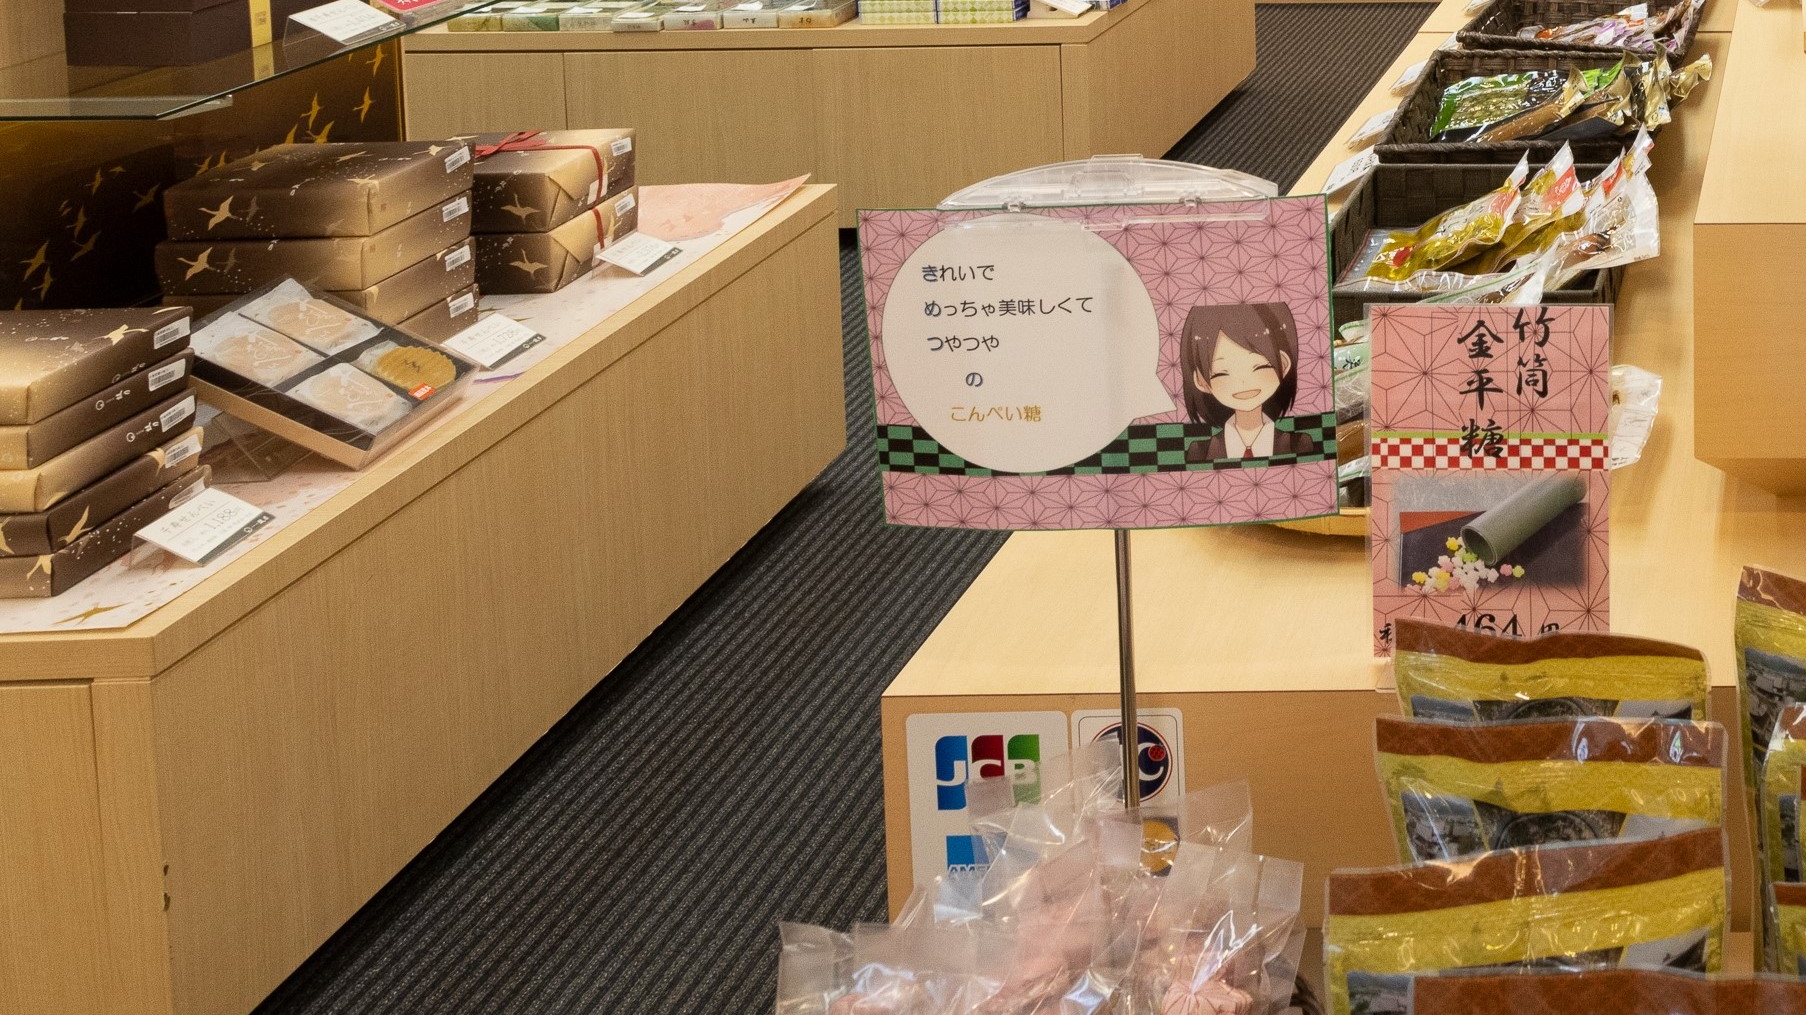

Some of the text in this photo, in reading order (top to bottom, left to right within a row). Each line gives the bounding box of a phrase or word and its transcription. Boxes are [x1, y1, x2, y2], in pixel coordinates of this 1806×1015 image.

[921, 262, 995, 283] きれいで
[924, 294, 1095, 317] めっちゃ美味しくて
[926, 333, 1000, 352] つやつや
[1512, 305, 1556, 400] 竹筒
[965, 371, 984, 388] の
[1457, 317, 1506, 459] 金平糖
[950, 403, 1042, 425] こんぺい糖
